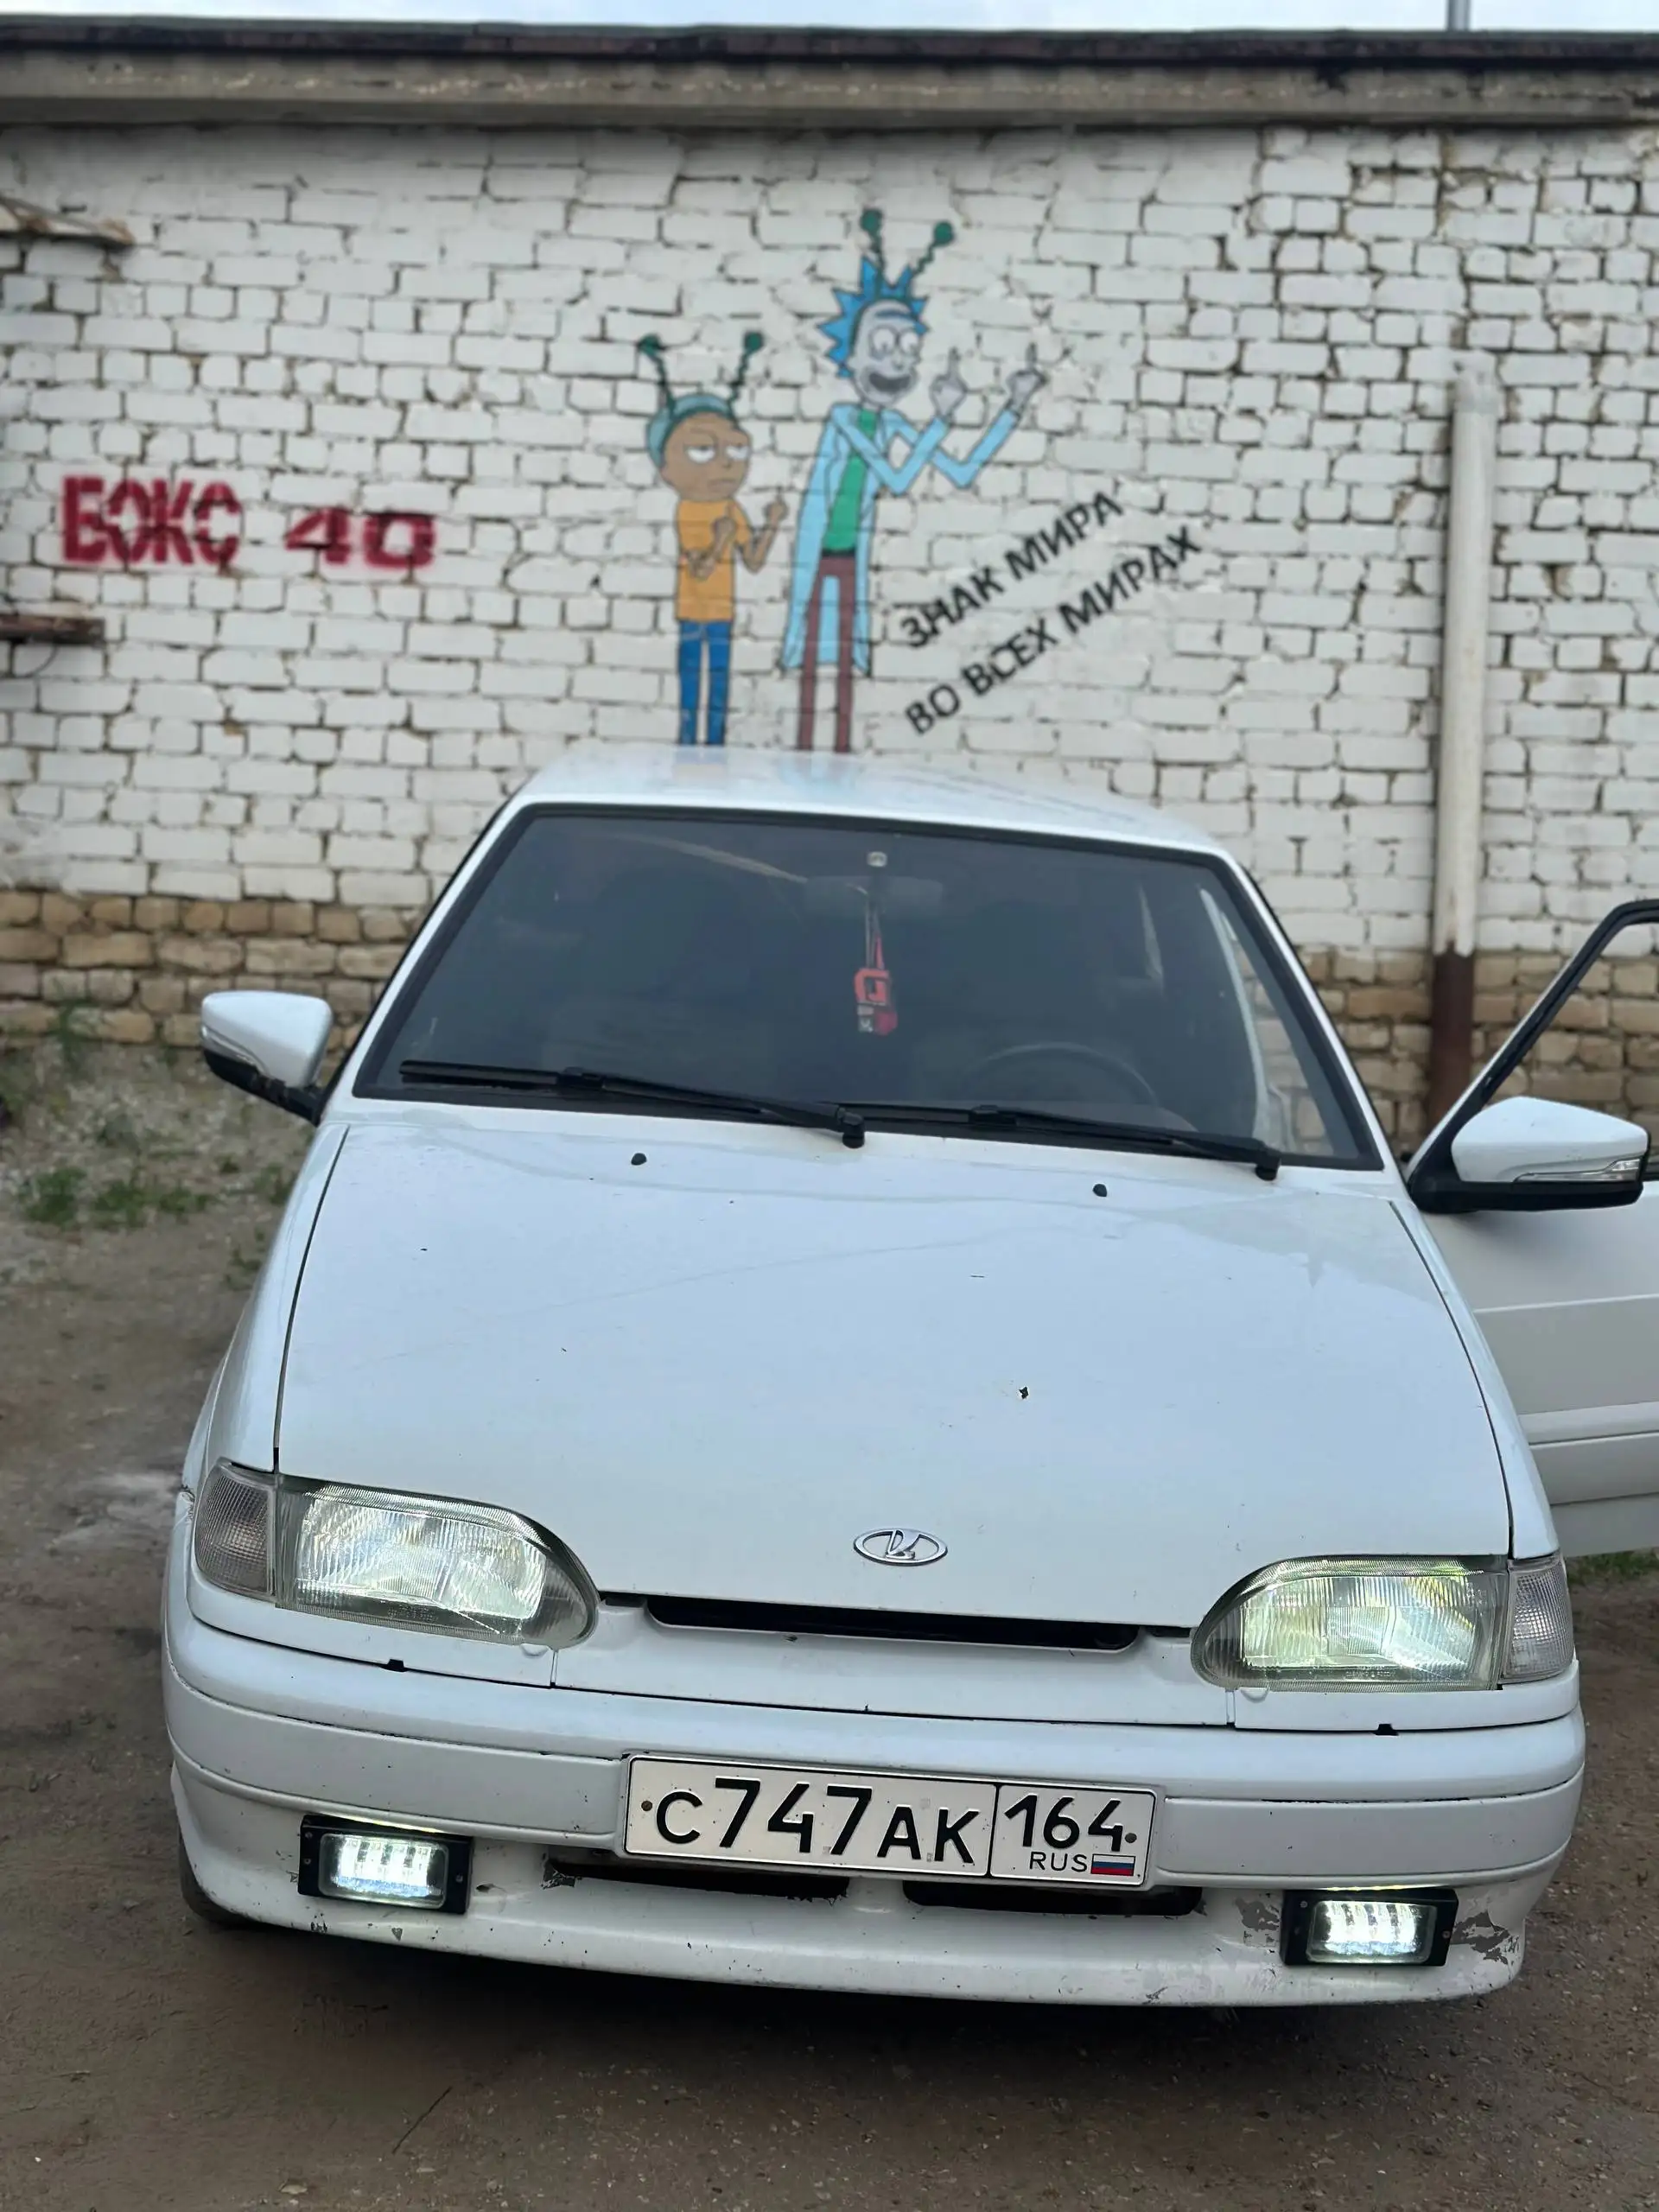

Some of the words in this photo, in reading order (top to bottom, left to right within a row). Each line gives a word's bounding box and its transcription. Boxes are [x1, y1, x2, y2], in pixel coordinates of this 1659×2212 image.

[61, 474, 244, 567] БОКС
[284, 505, 437, 569] 40
[900, 566, 1005, 649] ЗНАК
[1003, 490, 1124, 583] МИРА
[903, 684, 962, 735] ВО
[959, 616, 1059, 696] ВСЕХ
[1058, 524, 1203, 635] МИРАХ
[655, 1777, 981, 1864] С747АК
[1003, 1794, 1124, 1853] 164
[1028, 1850, 1089, 1873] RUS
